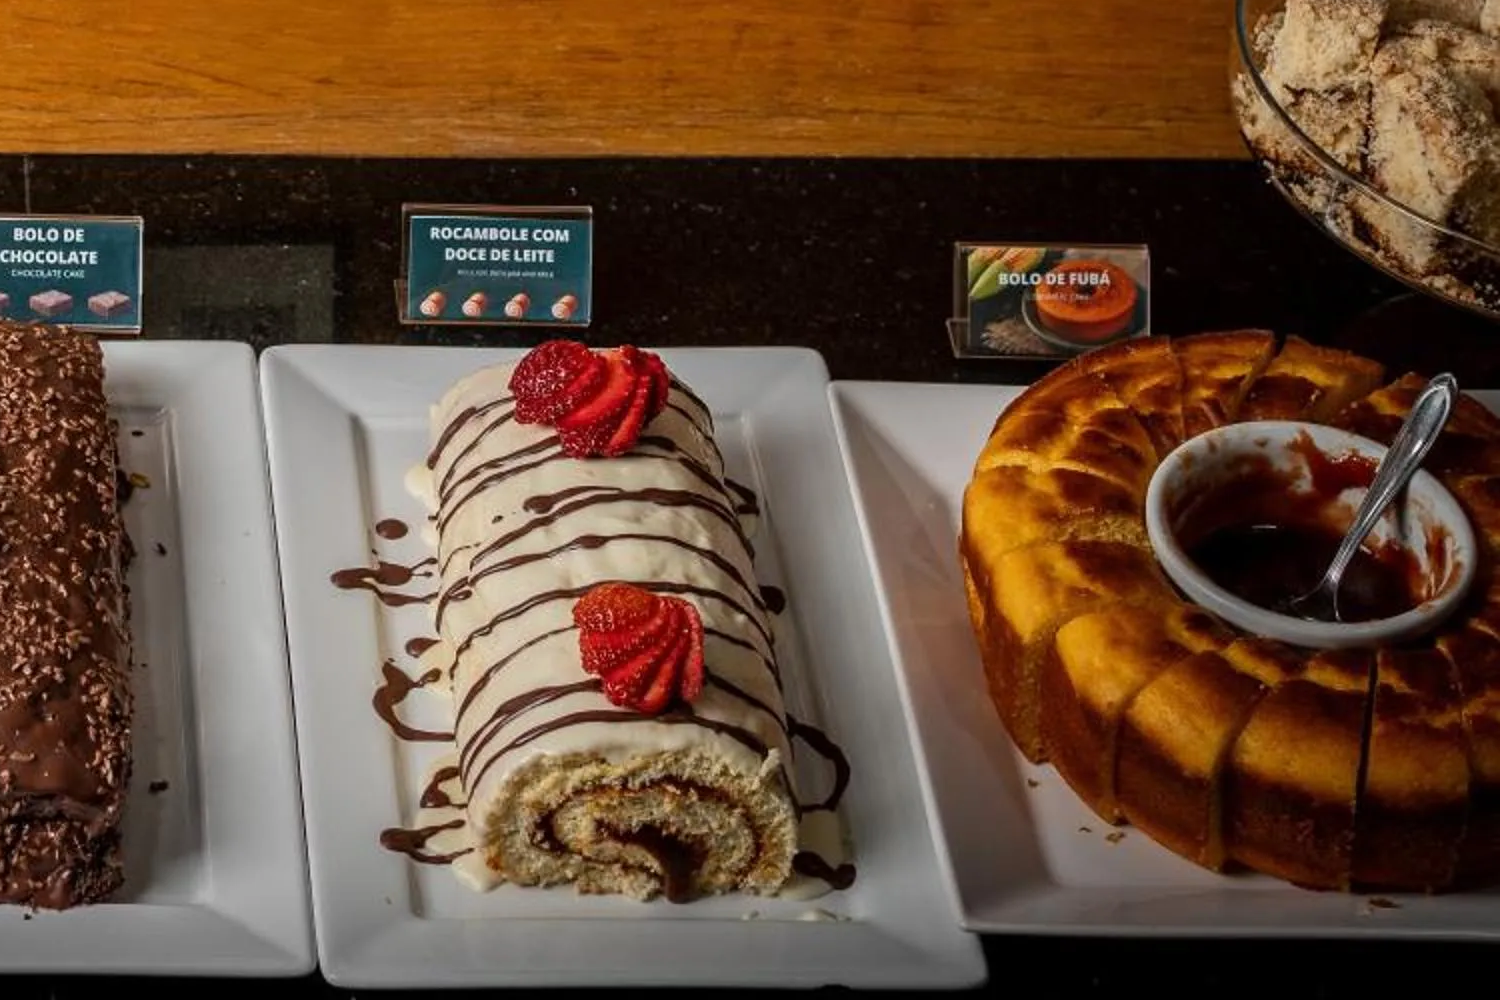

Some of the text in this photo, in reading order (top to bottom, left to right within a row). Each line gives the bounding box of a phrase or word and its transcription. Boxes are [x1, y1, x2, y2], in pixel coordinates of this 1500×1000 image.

[13, 227, 85, 243] BOLO DE
[430, 227, 569, 243] ROCAMBOLE COM
[0, 249, 99, 265] CHOCOLATE
[445, 247, 555, 263] DOCE DE LEITE
[11, 269, 85, 279] CHOCOLATE CAKE
[998, 269, 1111, 286] BOLO DE FUBÁ
